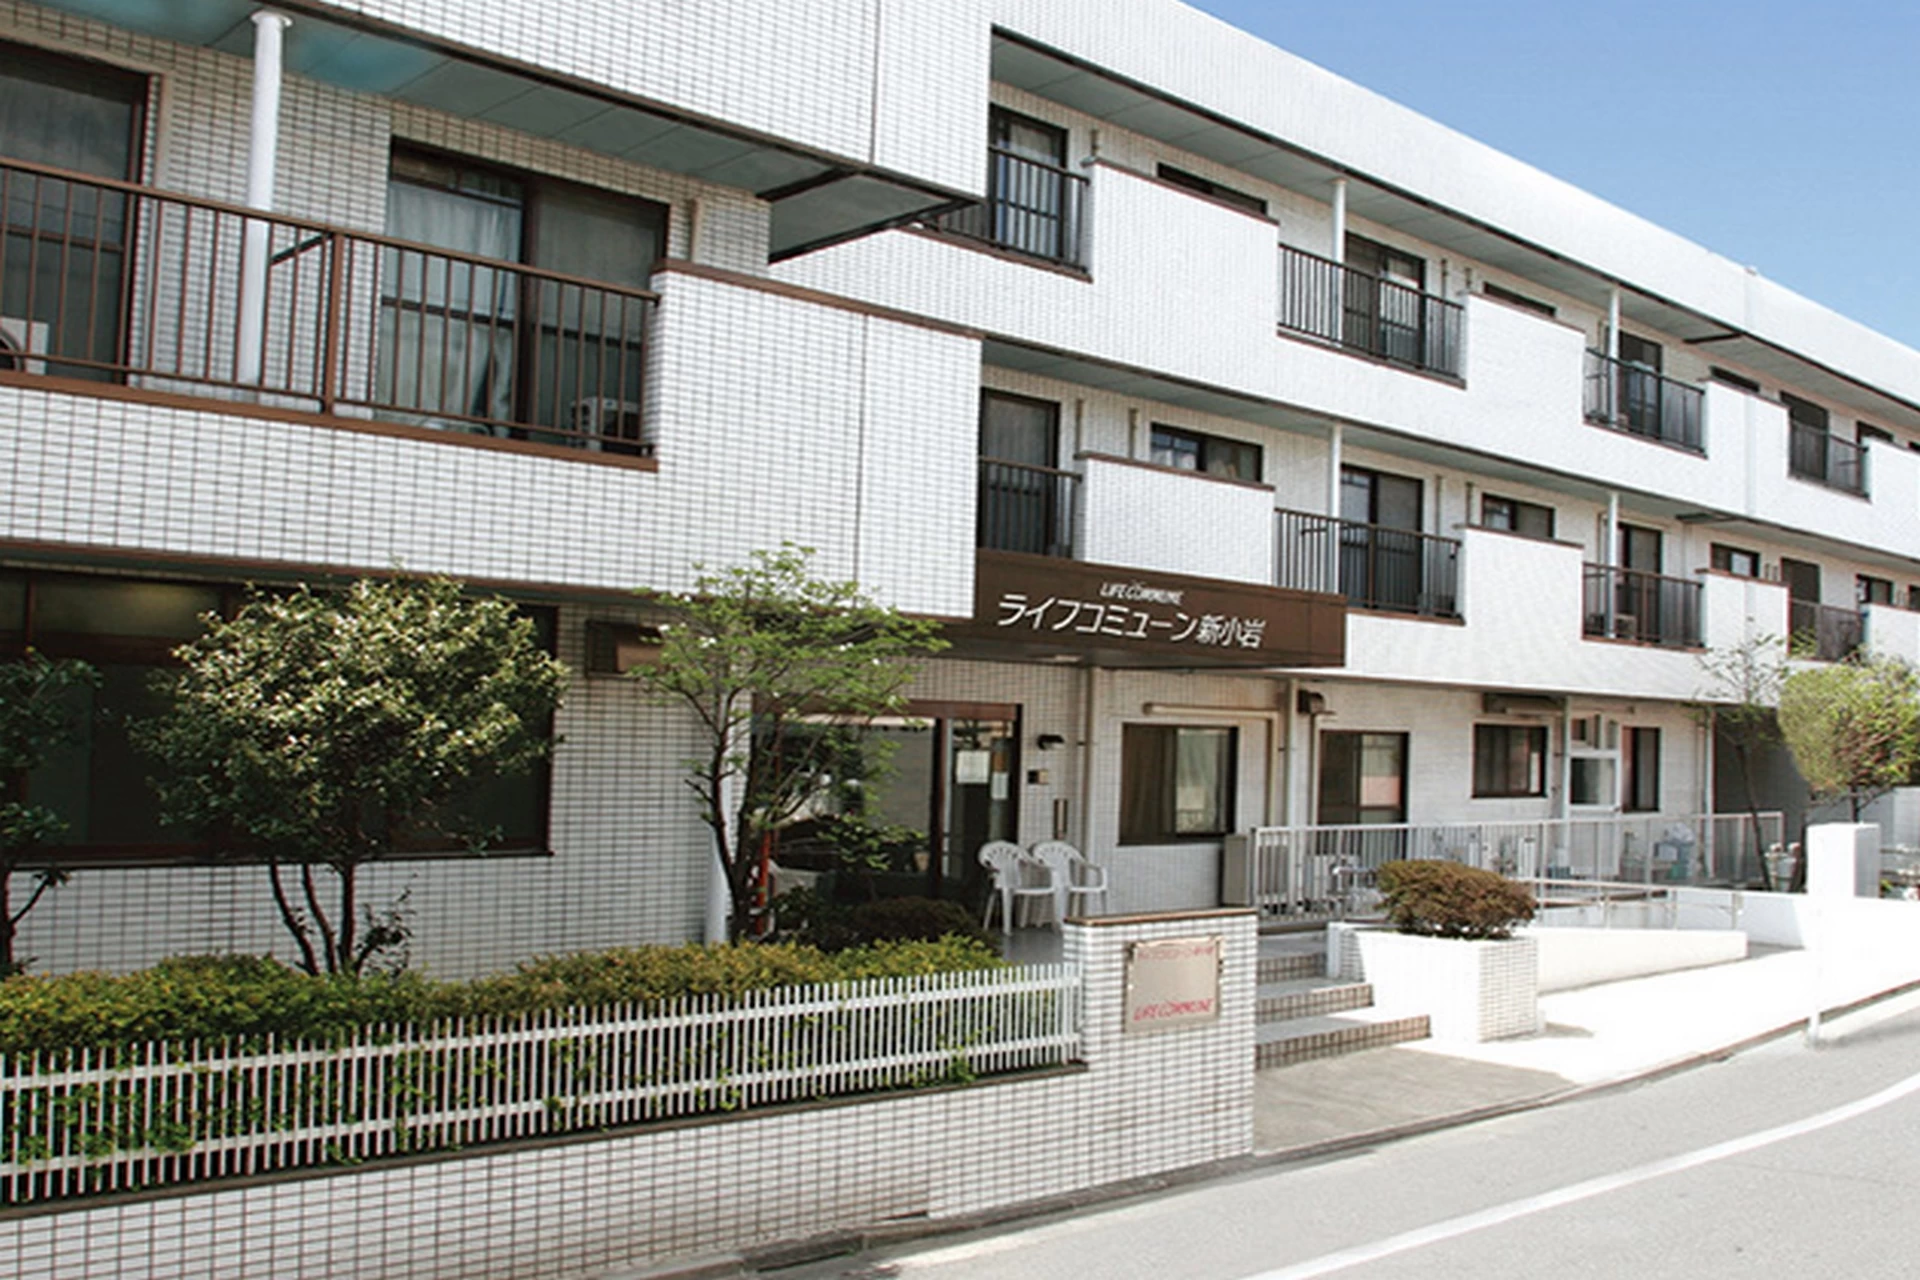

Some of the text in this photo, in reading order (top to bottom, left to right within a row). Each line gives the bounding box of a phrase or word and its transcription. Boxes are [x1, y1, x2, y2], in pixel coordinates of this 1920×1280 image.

[998, 594, 1266, 648] ライフコミューン新小岩
